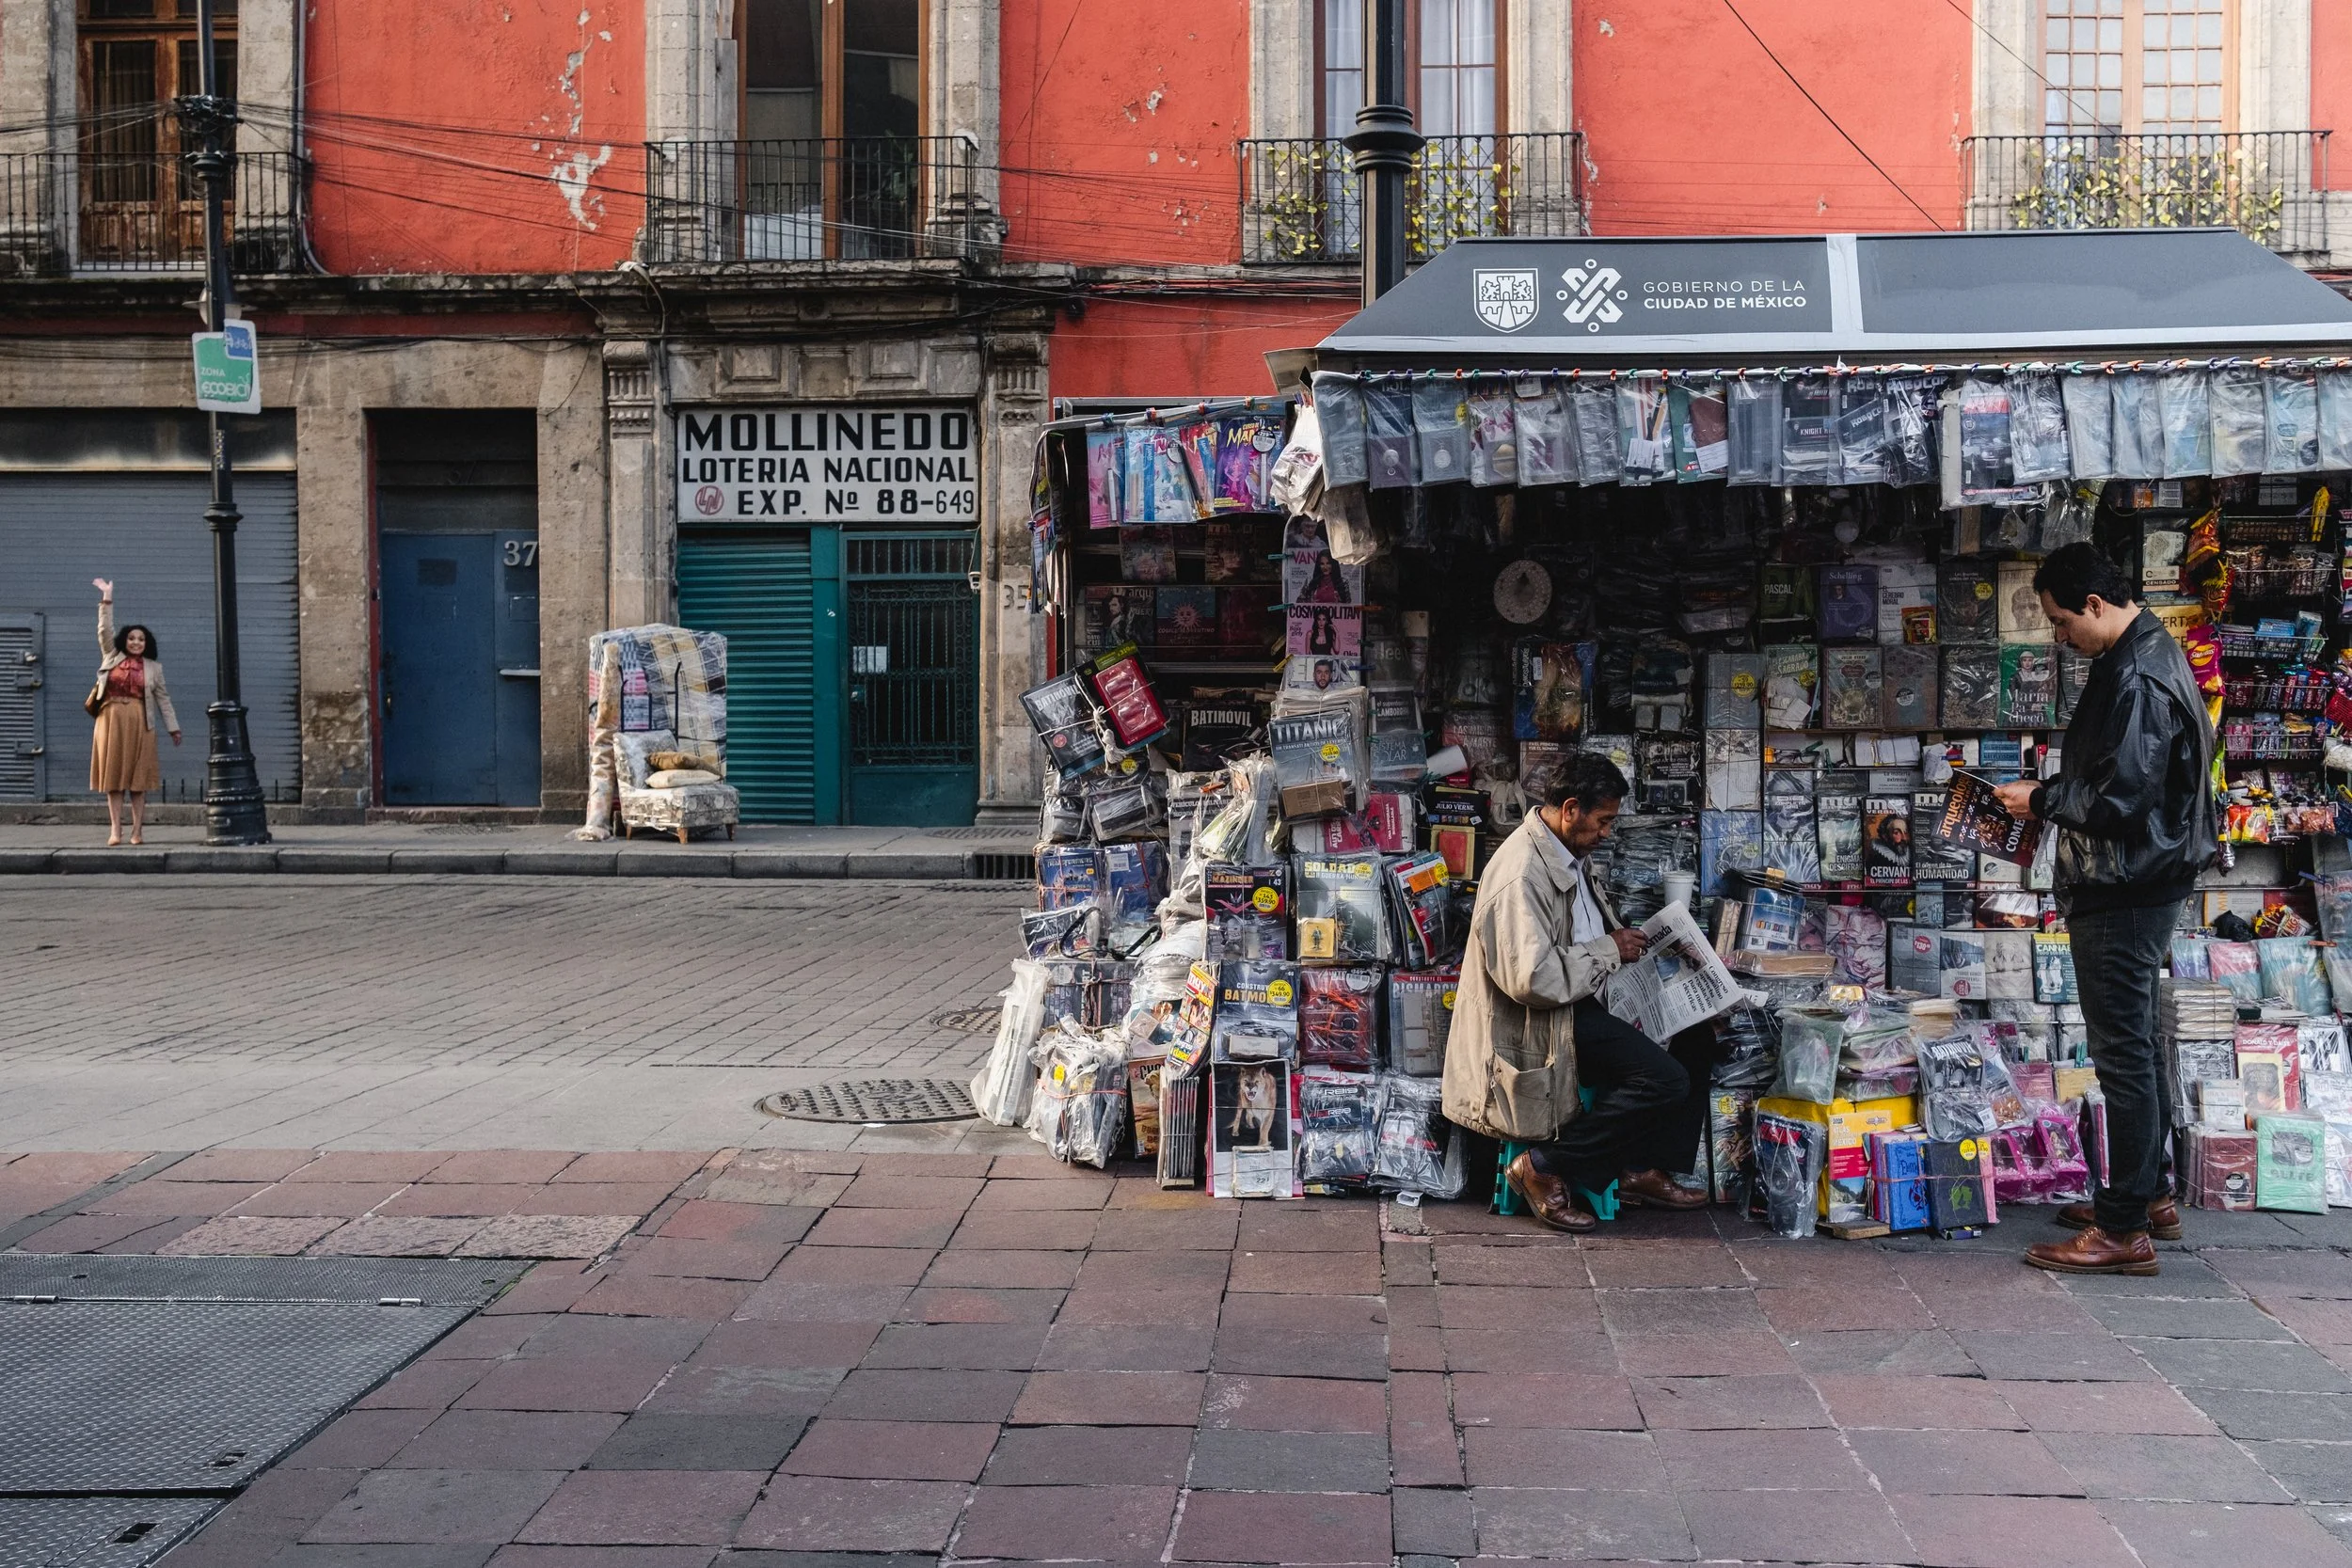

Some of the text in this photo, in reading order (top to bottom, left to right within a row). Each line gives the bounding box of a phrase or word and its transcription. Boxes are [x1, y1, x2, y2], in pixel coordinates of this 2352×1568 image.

[1643, 279, 1805, 293] GOBIERNO DE LA
[1643, 293, 1807, 309] CIUDAD DE MÉXICO
[199, 367, 226, 377] ZONA
[685, 413, 969, 452] MOLLINEDO
[682, 456, 975, 484] LOTERIA NACIONAL
[738, 489, 807, 515] EXP.
[876, 489, 975, 515] 88-649
[502, 540, 539, 567] 37
[1764, 583, 1794, 594] PASCAL
[1829, 572, 1863, 580] Schelling
[1003, 584, 1031, 610] 35
[1374, 740, 1406, 750] SISTEMA
[2006, 819, 2026, 853] COME
[1915, 869, 1969, 879] HUMANIDAD
[1694, 975, 1713, 1009] regulación
[1698, 973, 1715, 999] aprueba
[1703, 970, 1724, 1000] capitalino
[1708, 965, 1728, 994] Congreso
[1224, 990, 1270, 1002] BATMO
[1688, 979, 1707, 1013] para motos
